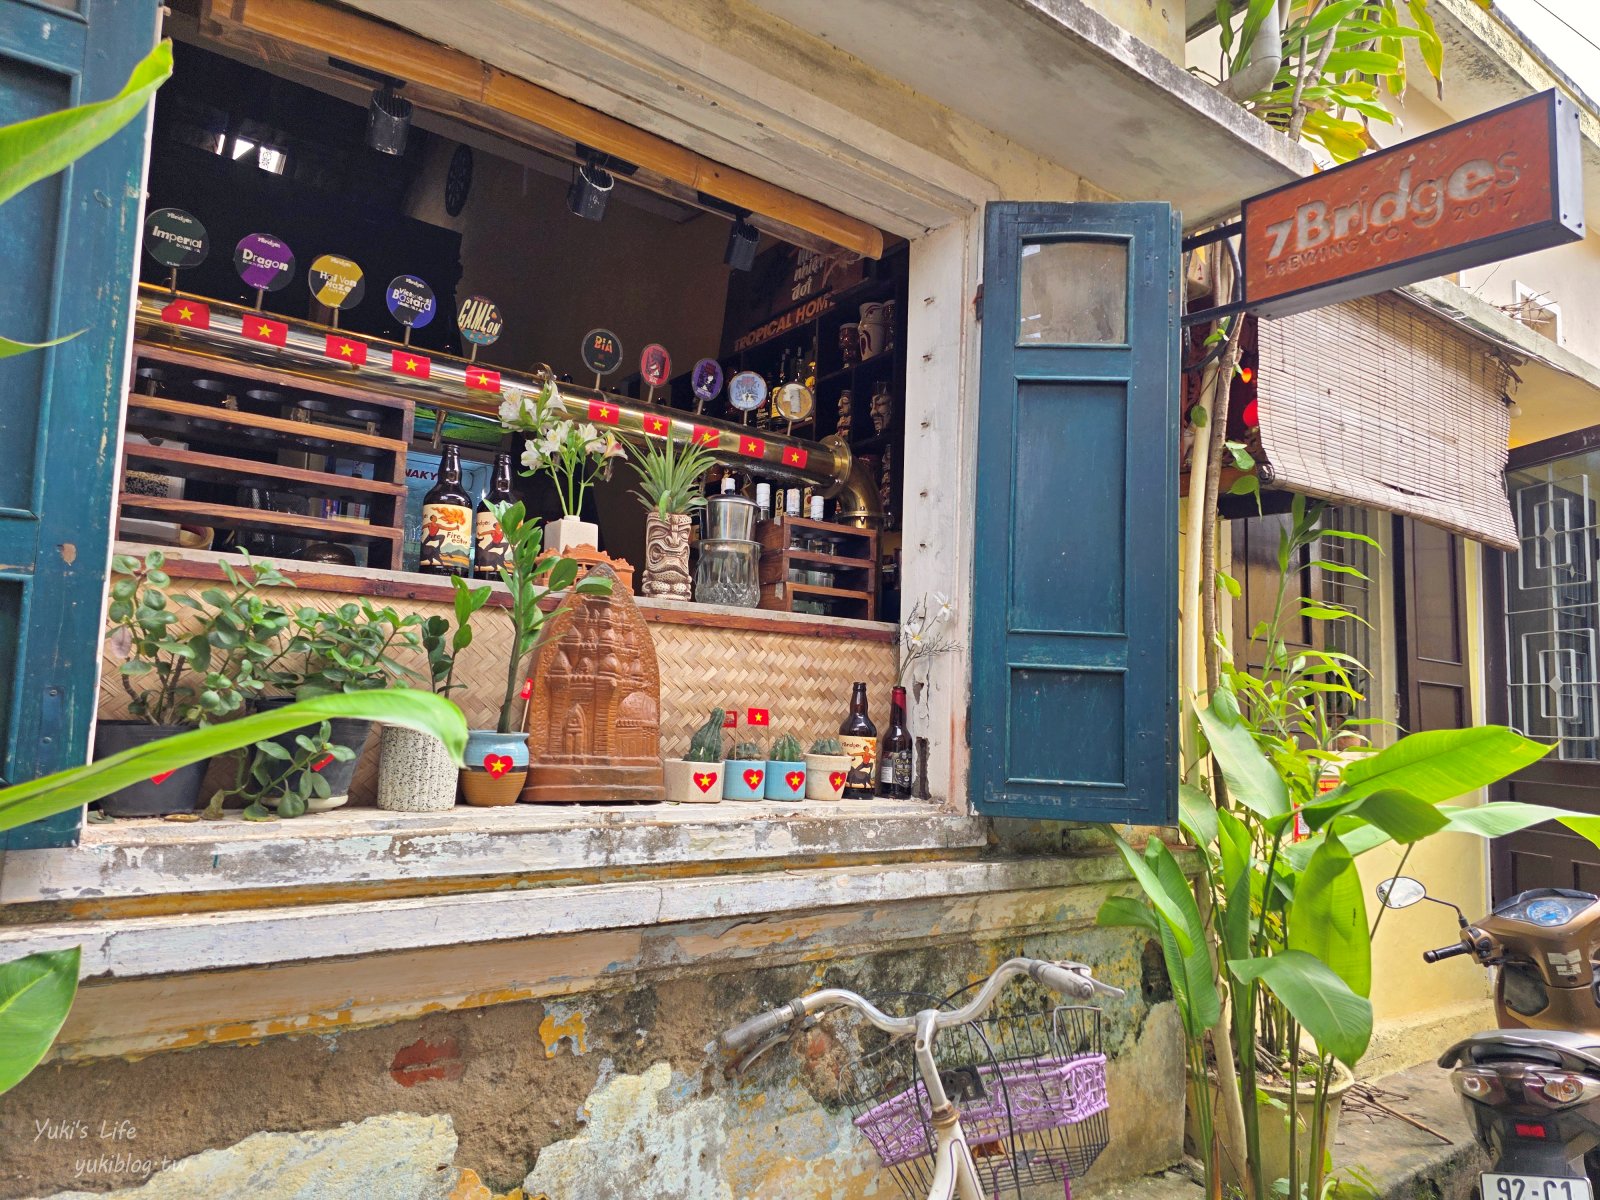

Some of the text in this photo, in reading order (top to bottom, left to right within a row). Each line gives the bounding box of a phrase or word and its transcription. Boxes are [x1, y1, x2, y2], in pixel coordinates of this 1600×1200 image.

[152, 225, 203, 249] Imperial
[242, 248, 289, 271] Dragon
[392, 289, 432, 311] Bastard
[734, 313, 792, 352] TROPICAL
